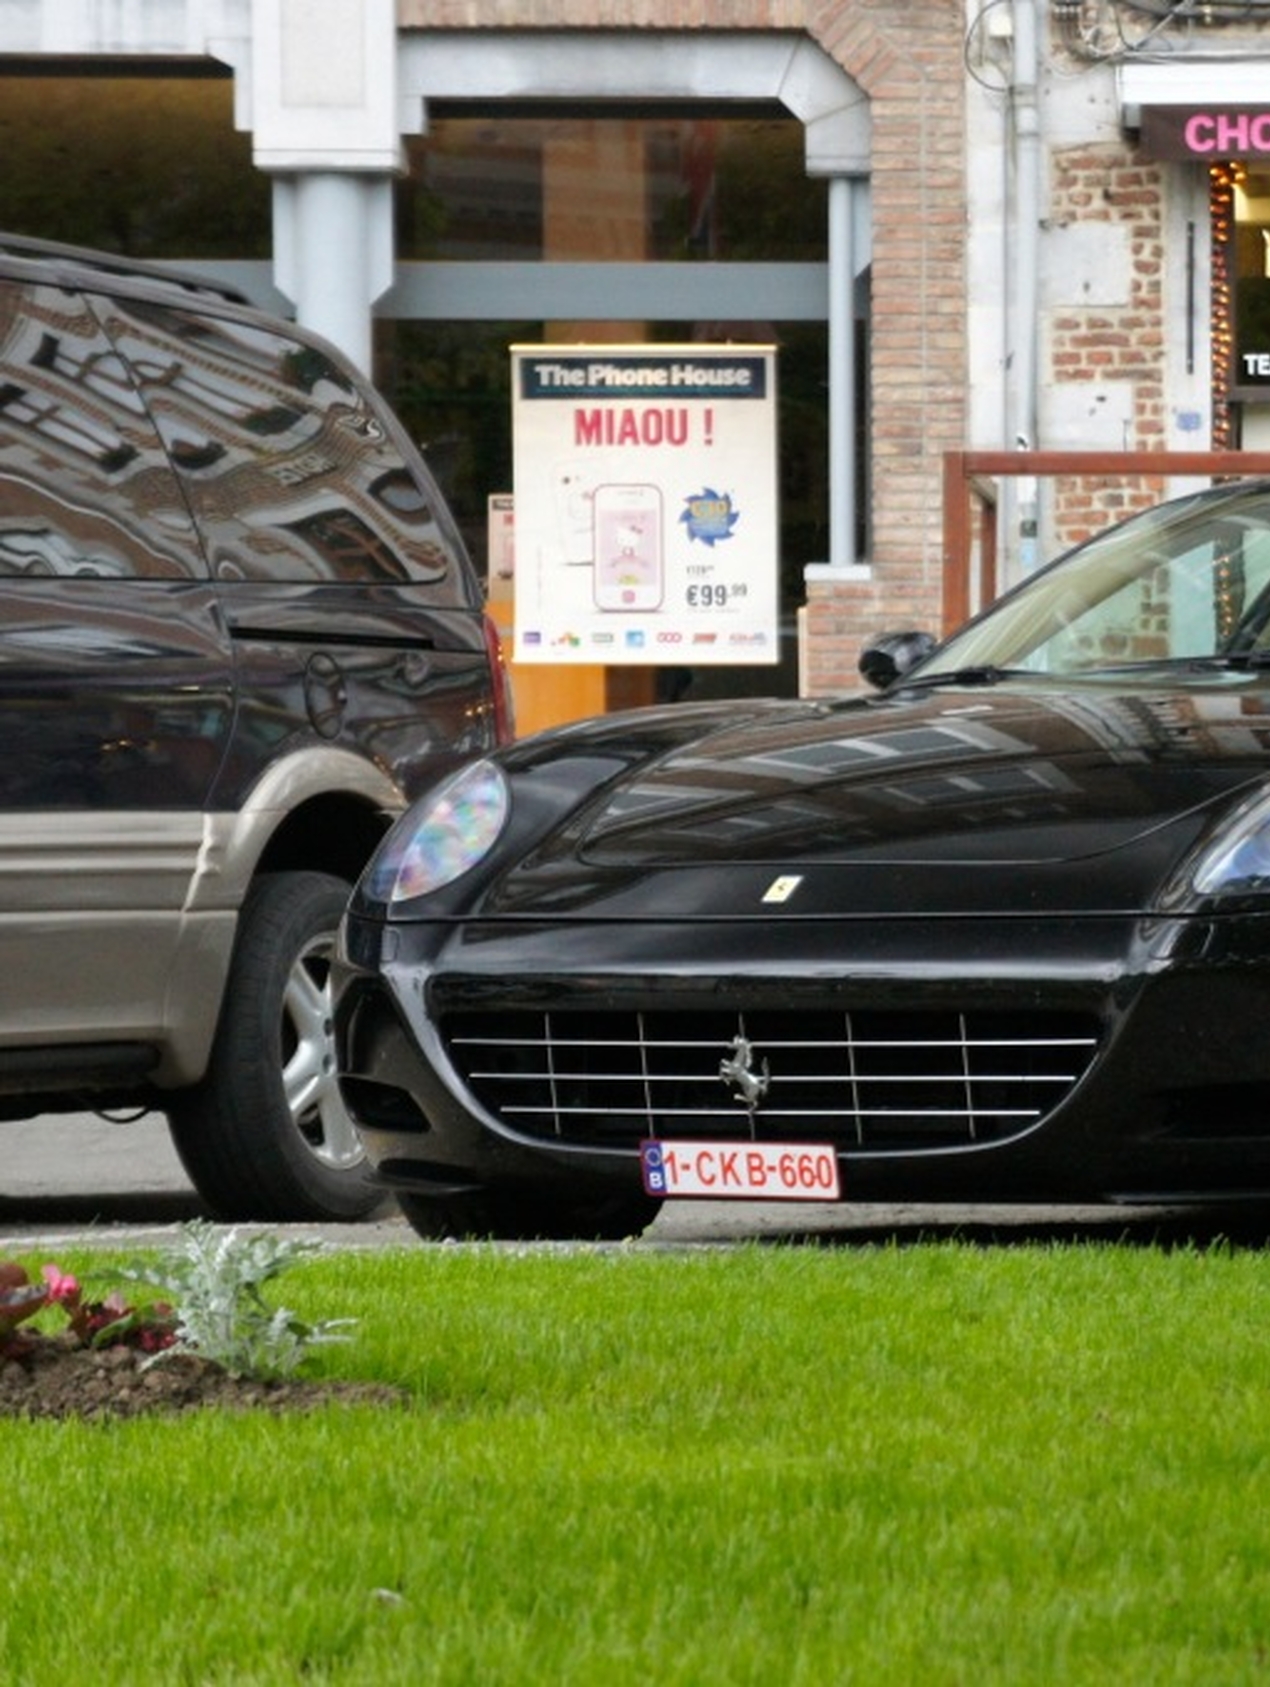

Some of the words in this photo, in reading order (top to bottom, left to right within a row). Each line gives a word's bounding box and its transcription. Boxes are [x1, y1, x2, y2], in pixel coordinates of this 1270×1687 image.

[534, 364, 587, 386] The
[587, 363, 667, 386] Phone
[671, 363, 751, 386] House
[574, 408, 688, 446] MIAOU
[650, 1173, 662, 1188] B
[664, 1150, 834, 1188] 1-CKB-660
